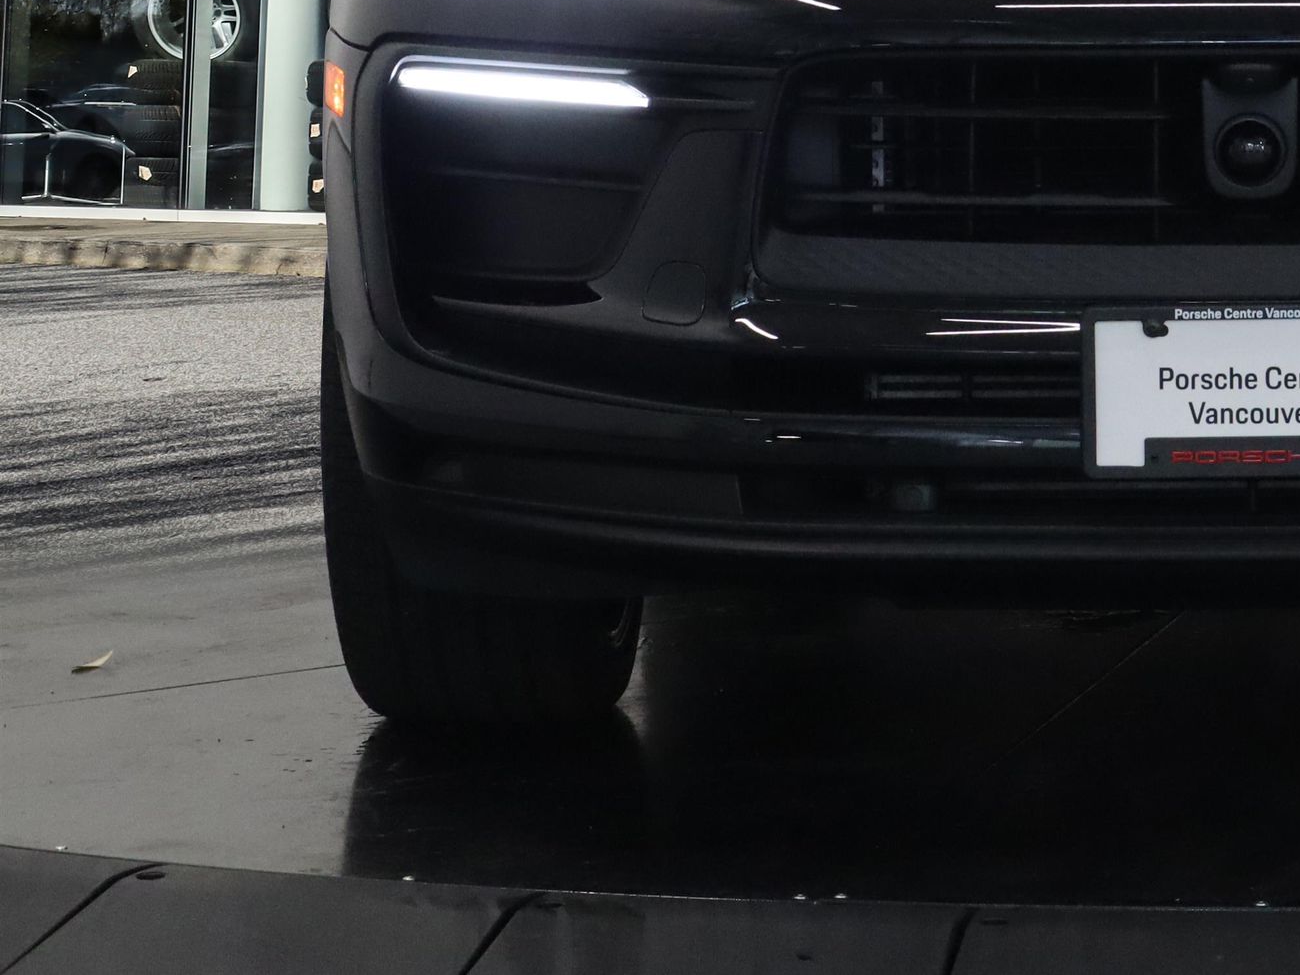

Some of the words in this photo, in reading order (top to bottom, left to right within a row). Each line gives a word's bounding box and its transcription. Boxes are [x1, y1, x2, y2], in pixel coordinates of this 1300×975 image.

[1174, 308, 1222, 320] Porsche
[1223, 307, 1263, 319] Centre
[1158, 366, 1258, 390] Porsche
